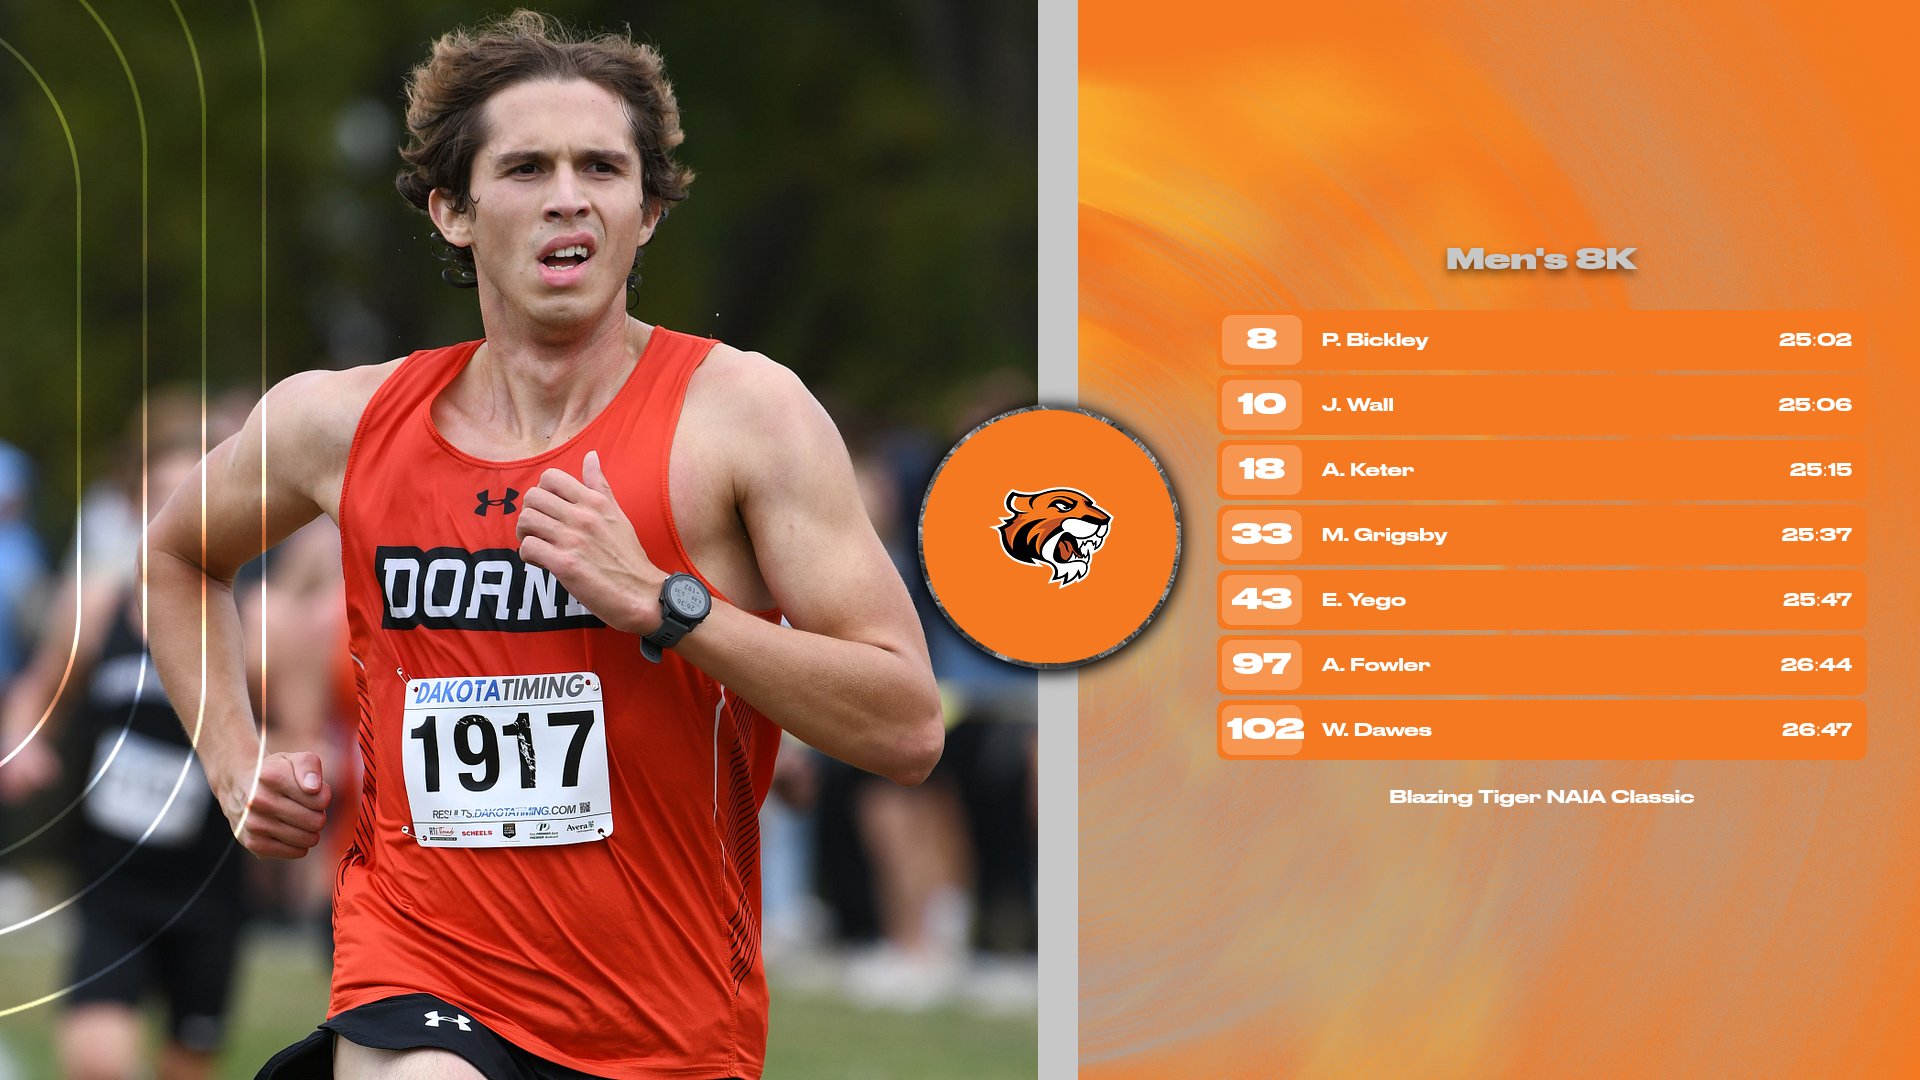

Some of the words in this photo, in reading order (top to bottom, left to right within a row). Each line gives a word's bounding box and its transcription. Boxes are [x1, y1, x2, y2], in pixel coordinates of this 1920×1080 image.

[415, 674, 585, 704] DAKOTATIMING
[411, 710, 595, 792] 1917
[566, 823, 589, 832] Avera
